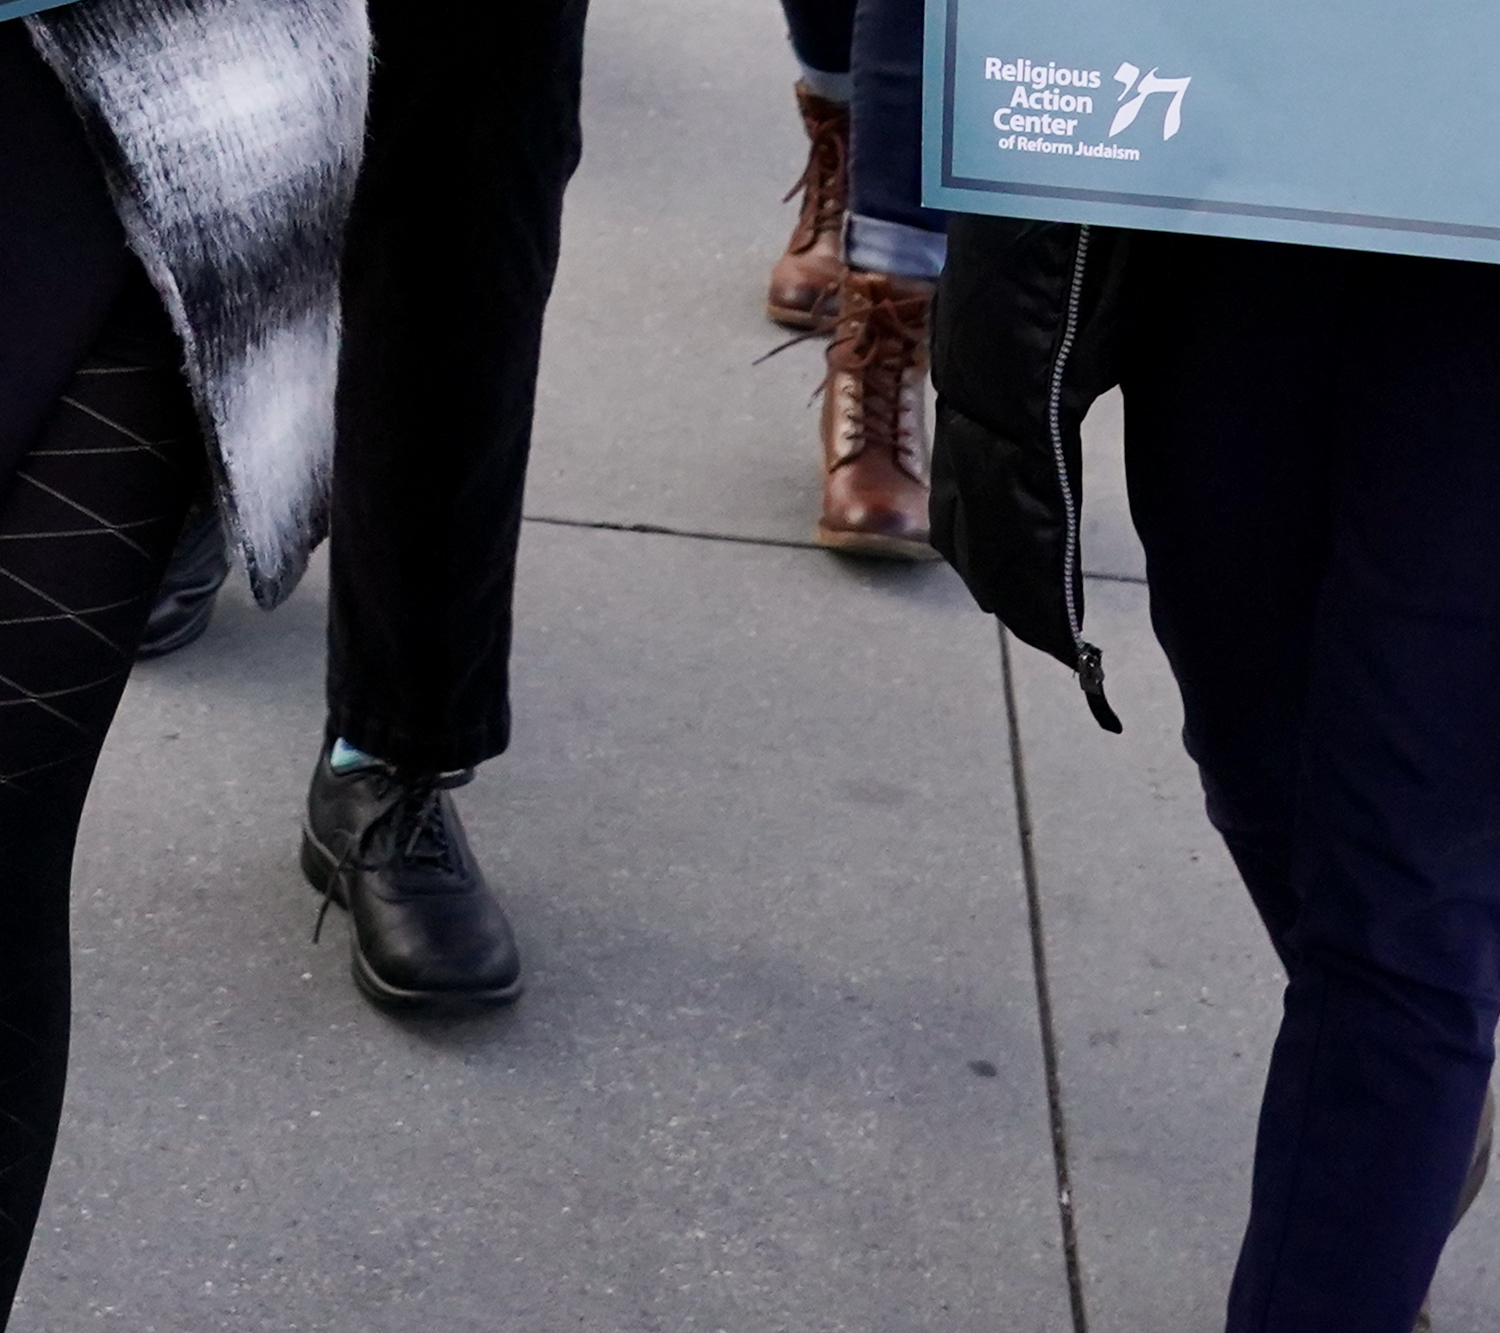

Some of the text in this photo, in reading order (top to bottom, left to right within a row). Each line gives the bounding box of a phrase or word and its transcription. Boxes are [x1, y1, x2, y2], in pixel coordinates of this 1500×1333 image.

[985, 57, 1101, 90] Religious
[1010, 85, 1093, 114] Action
[993, 108, 1078, 136] Center
[998, 134, 1140, 161] of Reform Judaism
